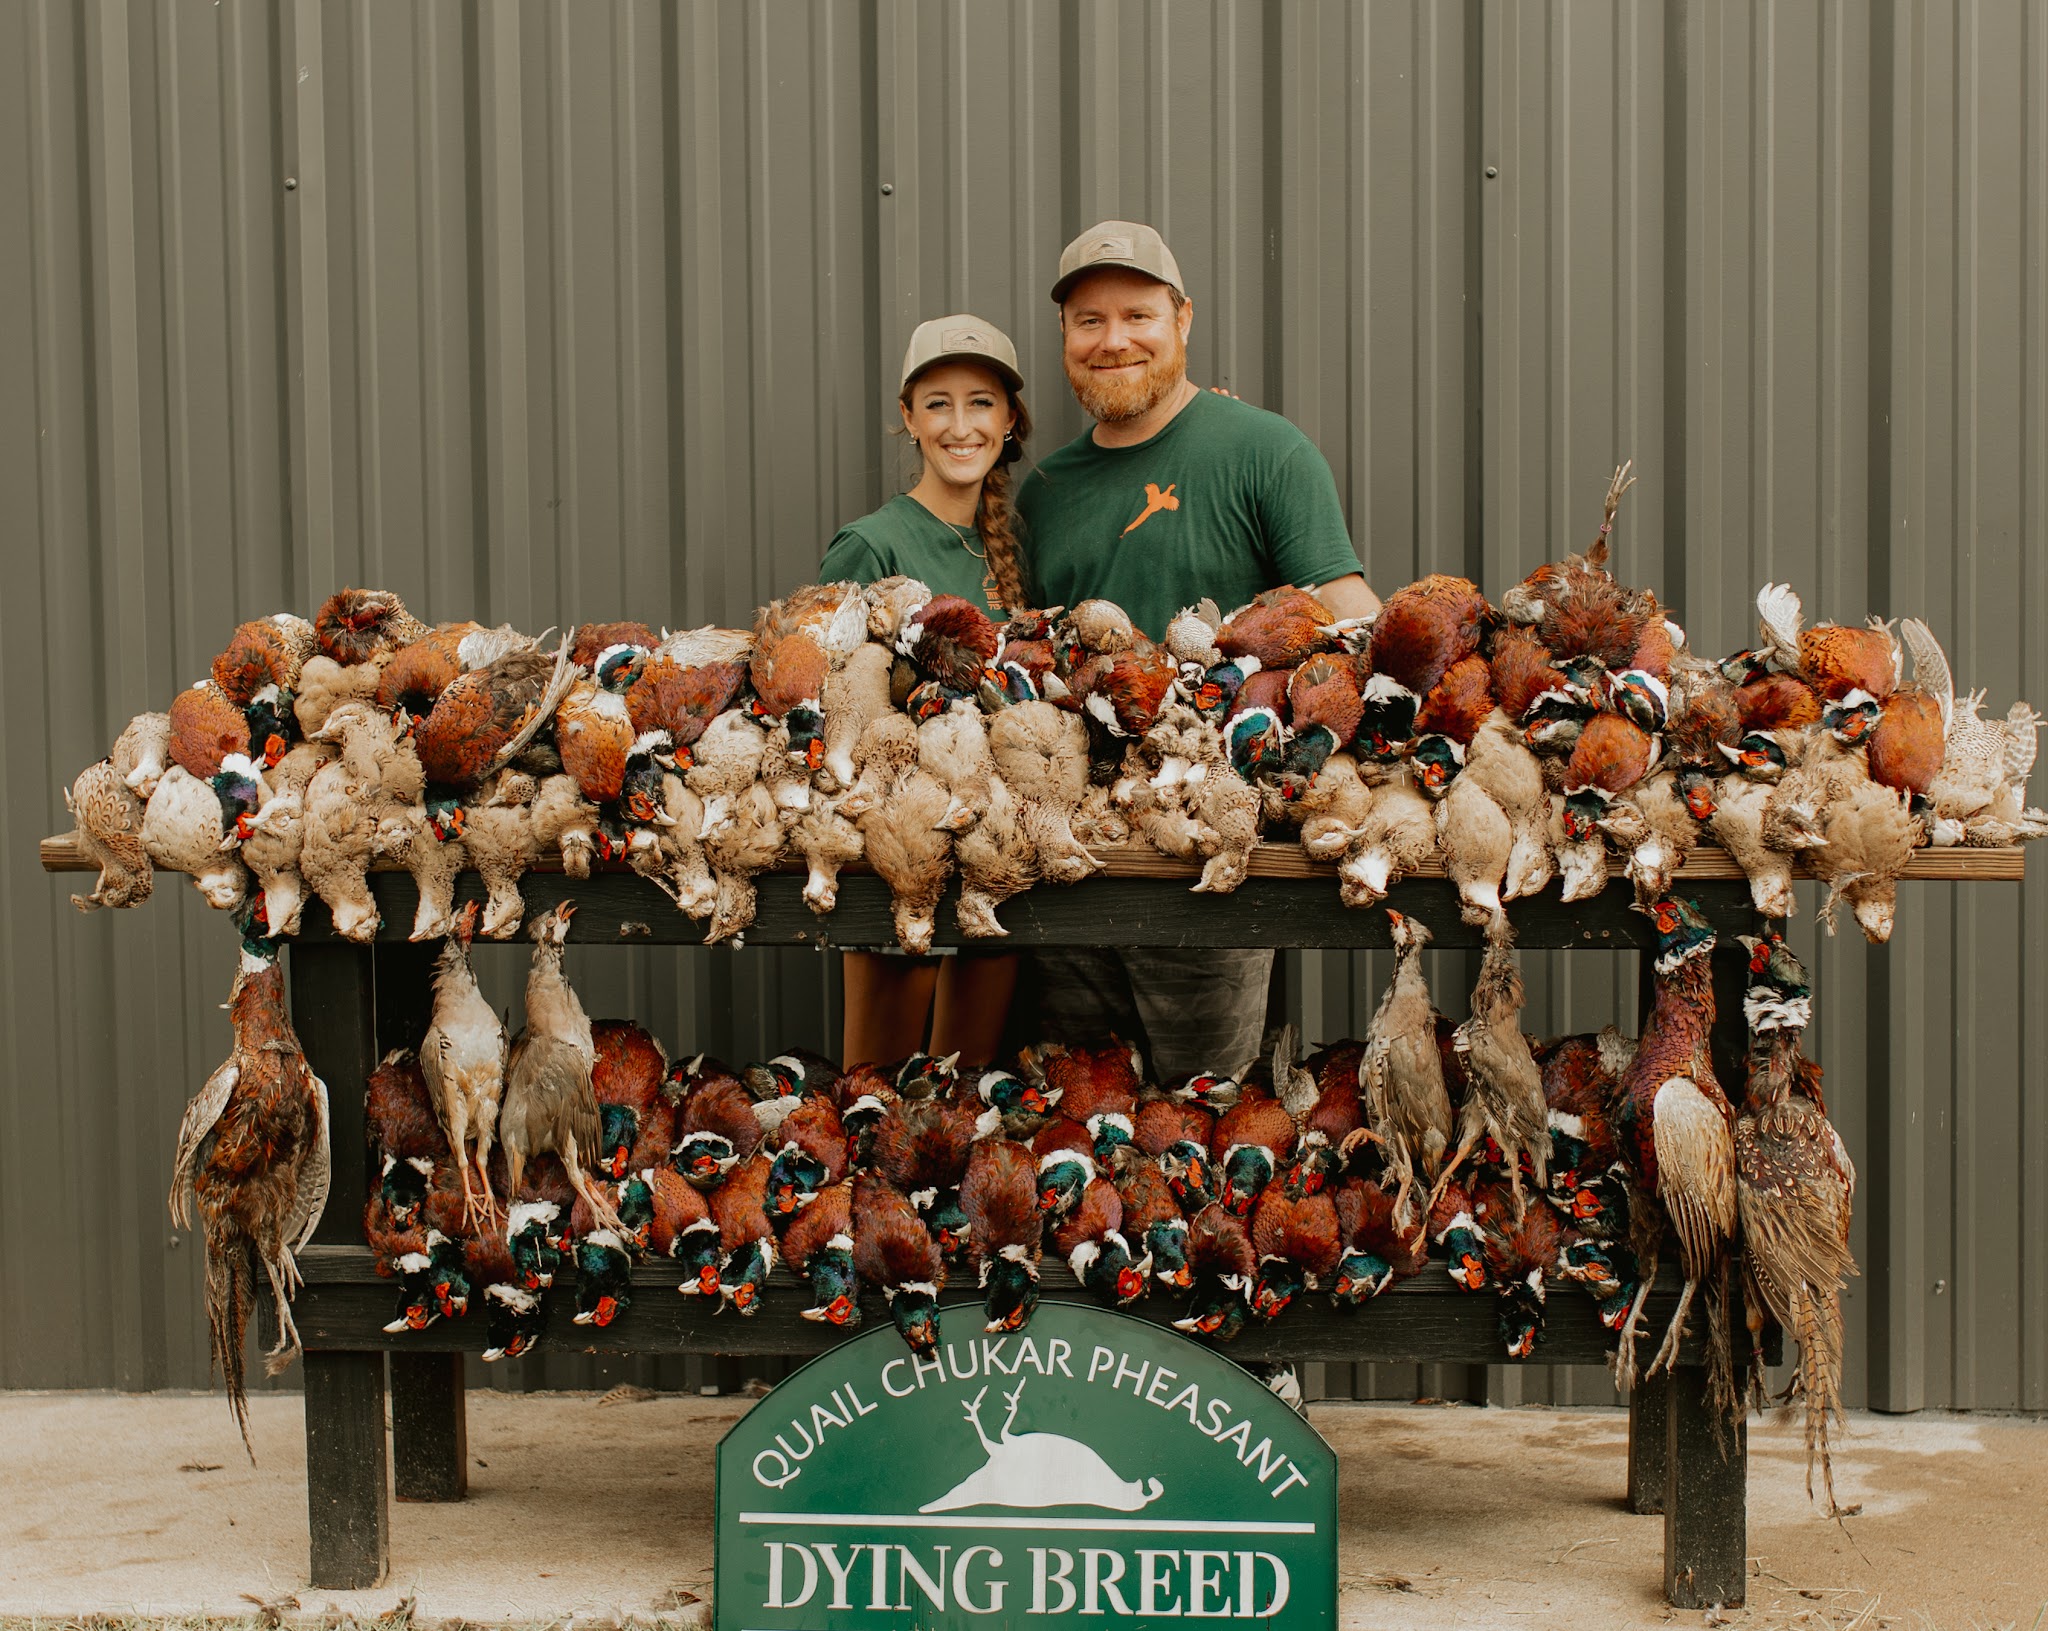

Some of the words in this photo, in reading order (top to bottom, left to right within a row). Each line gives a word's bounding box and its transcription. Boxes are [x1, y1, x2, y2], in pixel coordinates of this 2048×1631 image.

[752, 1381, 879, 1490] QUAIL
[881, 1336, 1074, 1398] CHUKAR
[1086, 1345, 1309, 1498] PHEASANT
[762, 1542, 1009, 1614] DYING
[1025, 1547, 1291, 1618] BREED
